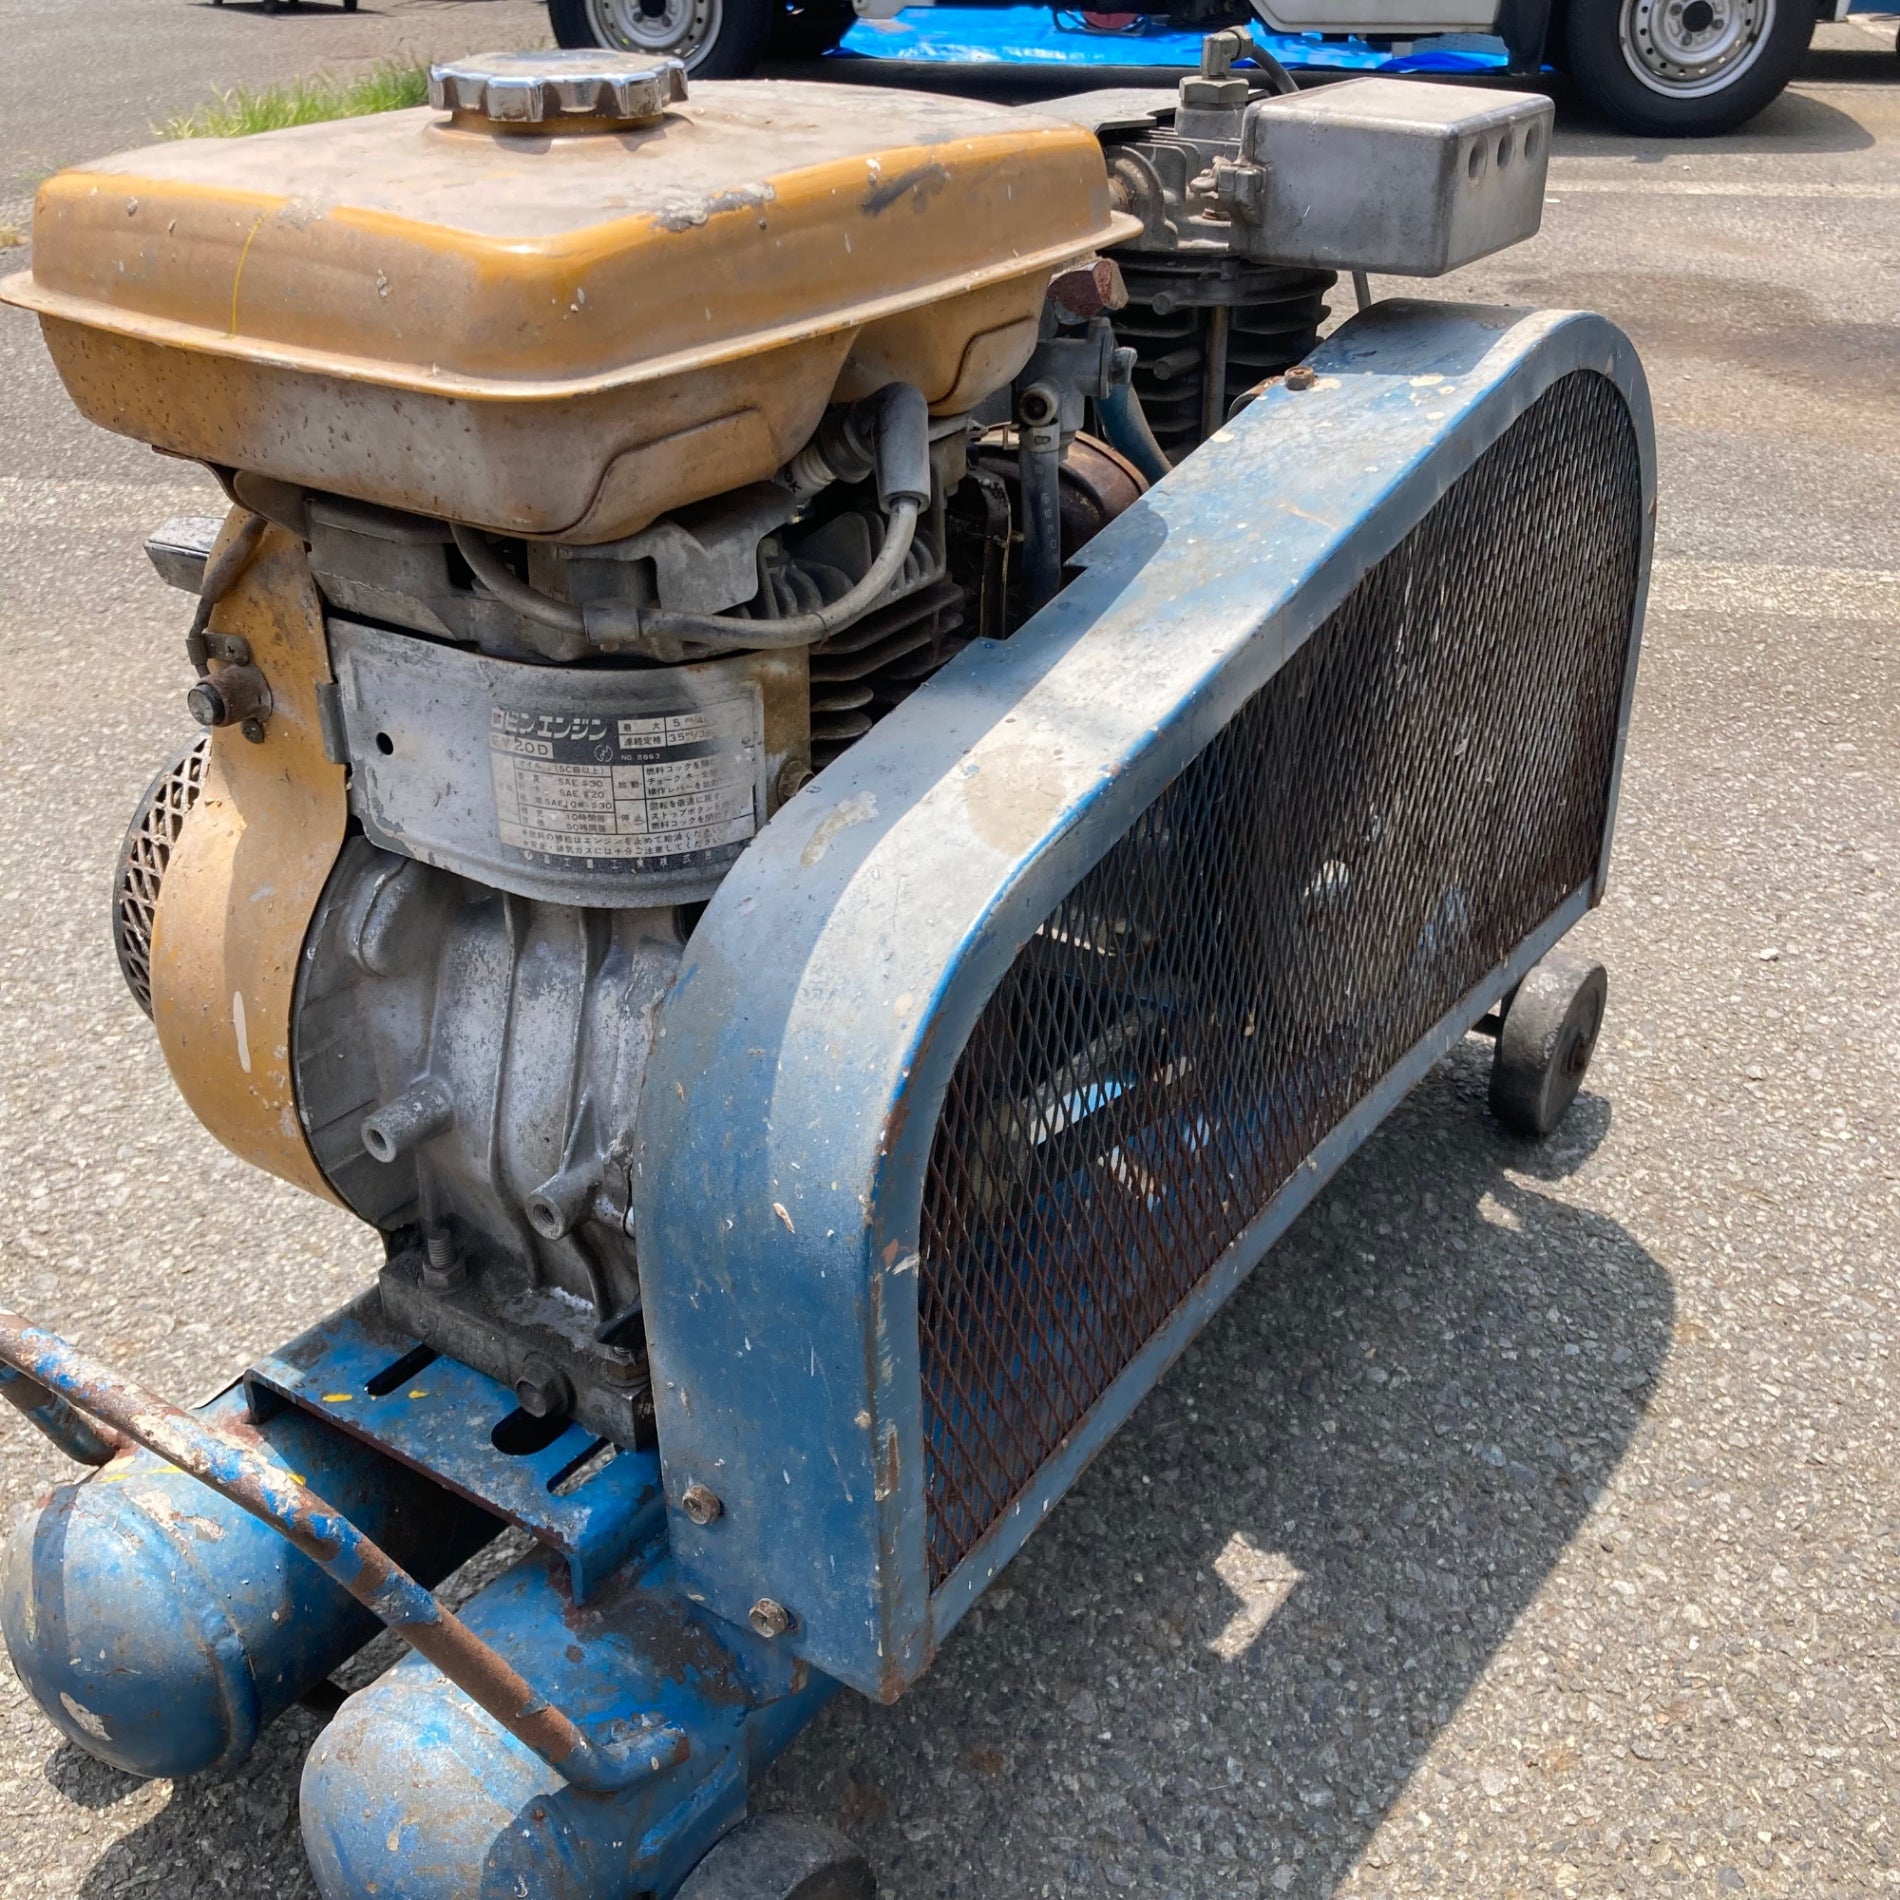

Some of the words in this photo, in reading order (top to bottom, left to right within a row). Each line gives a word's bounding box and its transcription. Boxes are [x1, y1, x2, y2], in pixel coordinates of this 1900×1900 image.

[491, 707, 607, 741] ロビンエンジン
[558, 778, 577, 787] SAE
[559, 789, 579, 798] SAE
